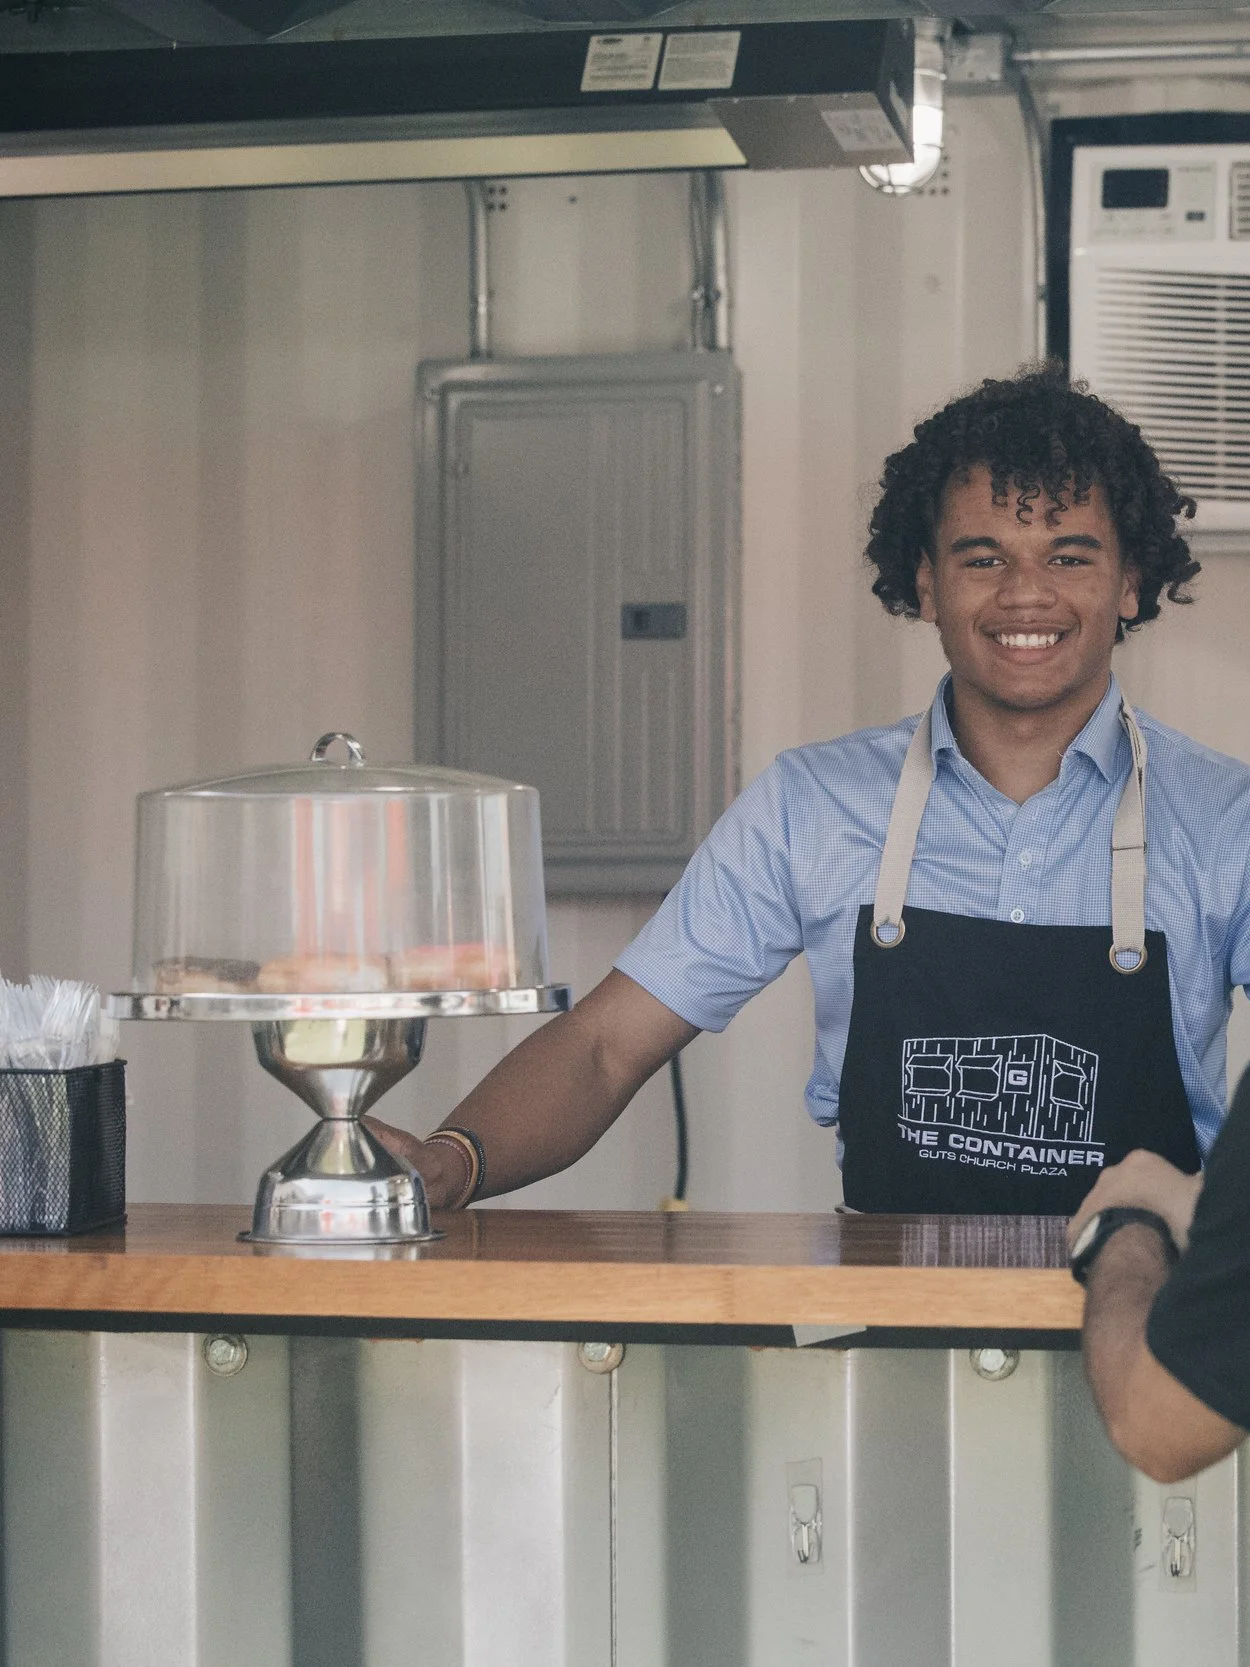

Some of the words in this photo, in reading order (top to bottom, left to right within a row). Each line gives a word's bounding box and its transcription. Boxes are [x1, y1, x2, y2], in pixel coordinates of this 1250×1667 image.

[1007, 1069, 1029, 1086] G
[897, 1122, 939, 1146] THE
[948, 1132, 1105, 1167] CONTAINER
[918, 1148, 957, 1161] GUTS
[959, 1153, 1017, 1172] CHURCH
[1020, 1164, 1068, 1177] PLAZA
